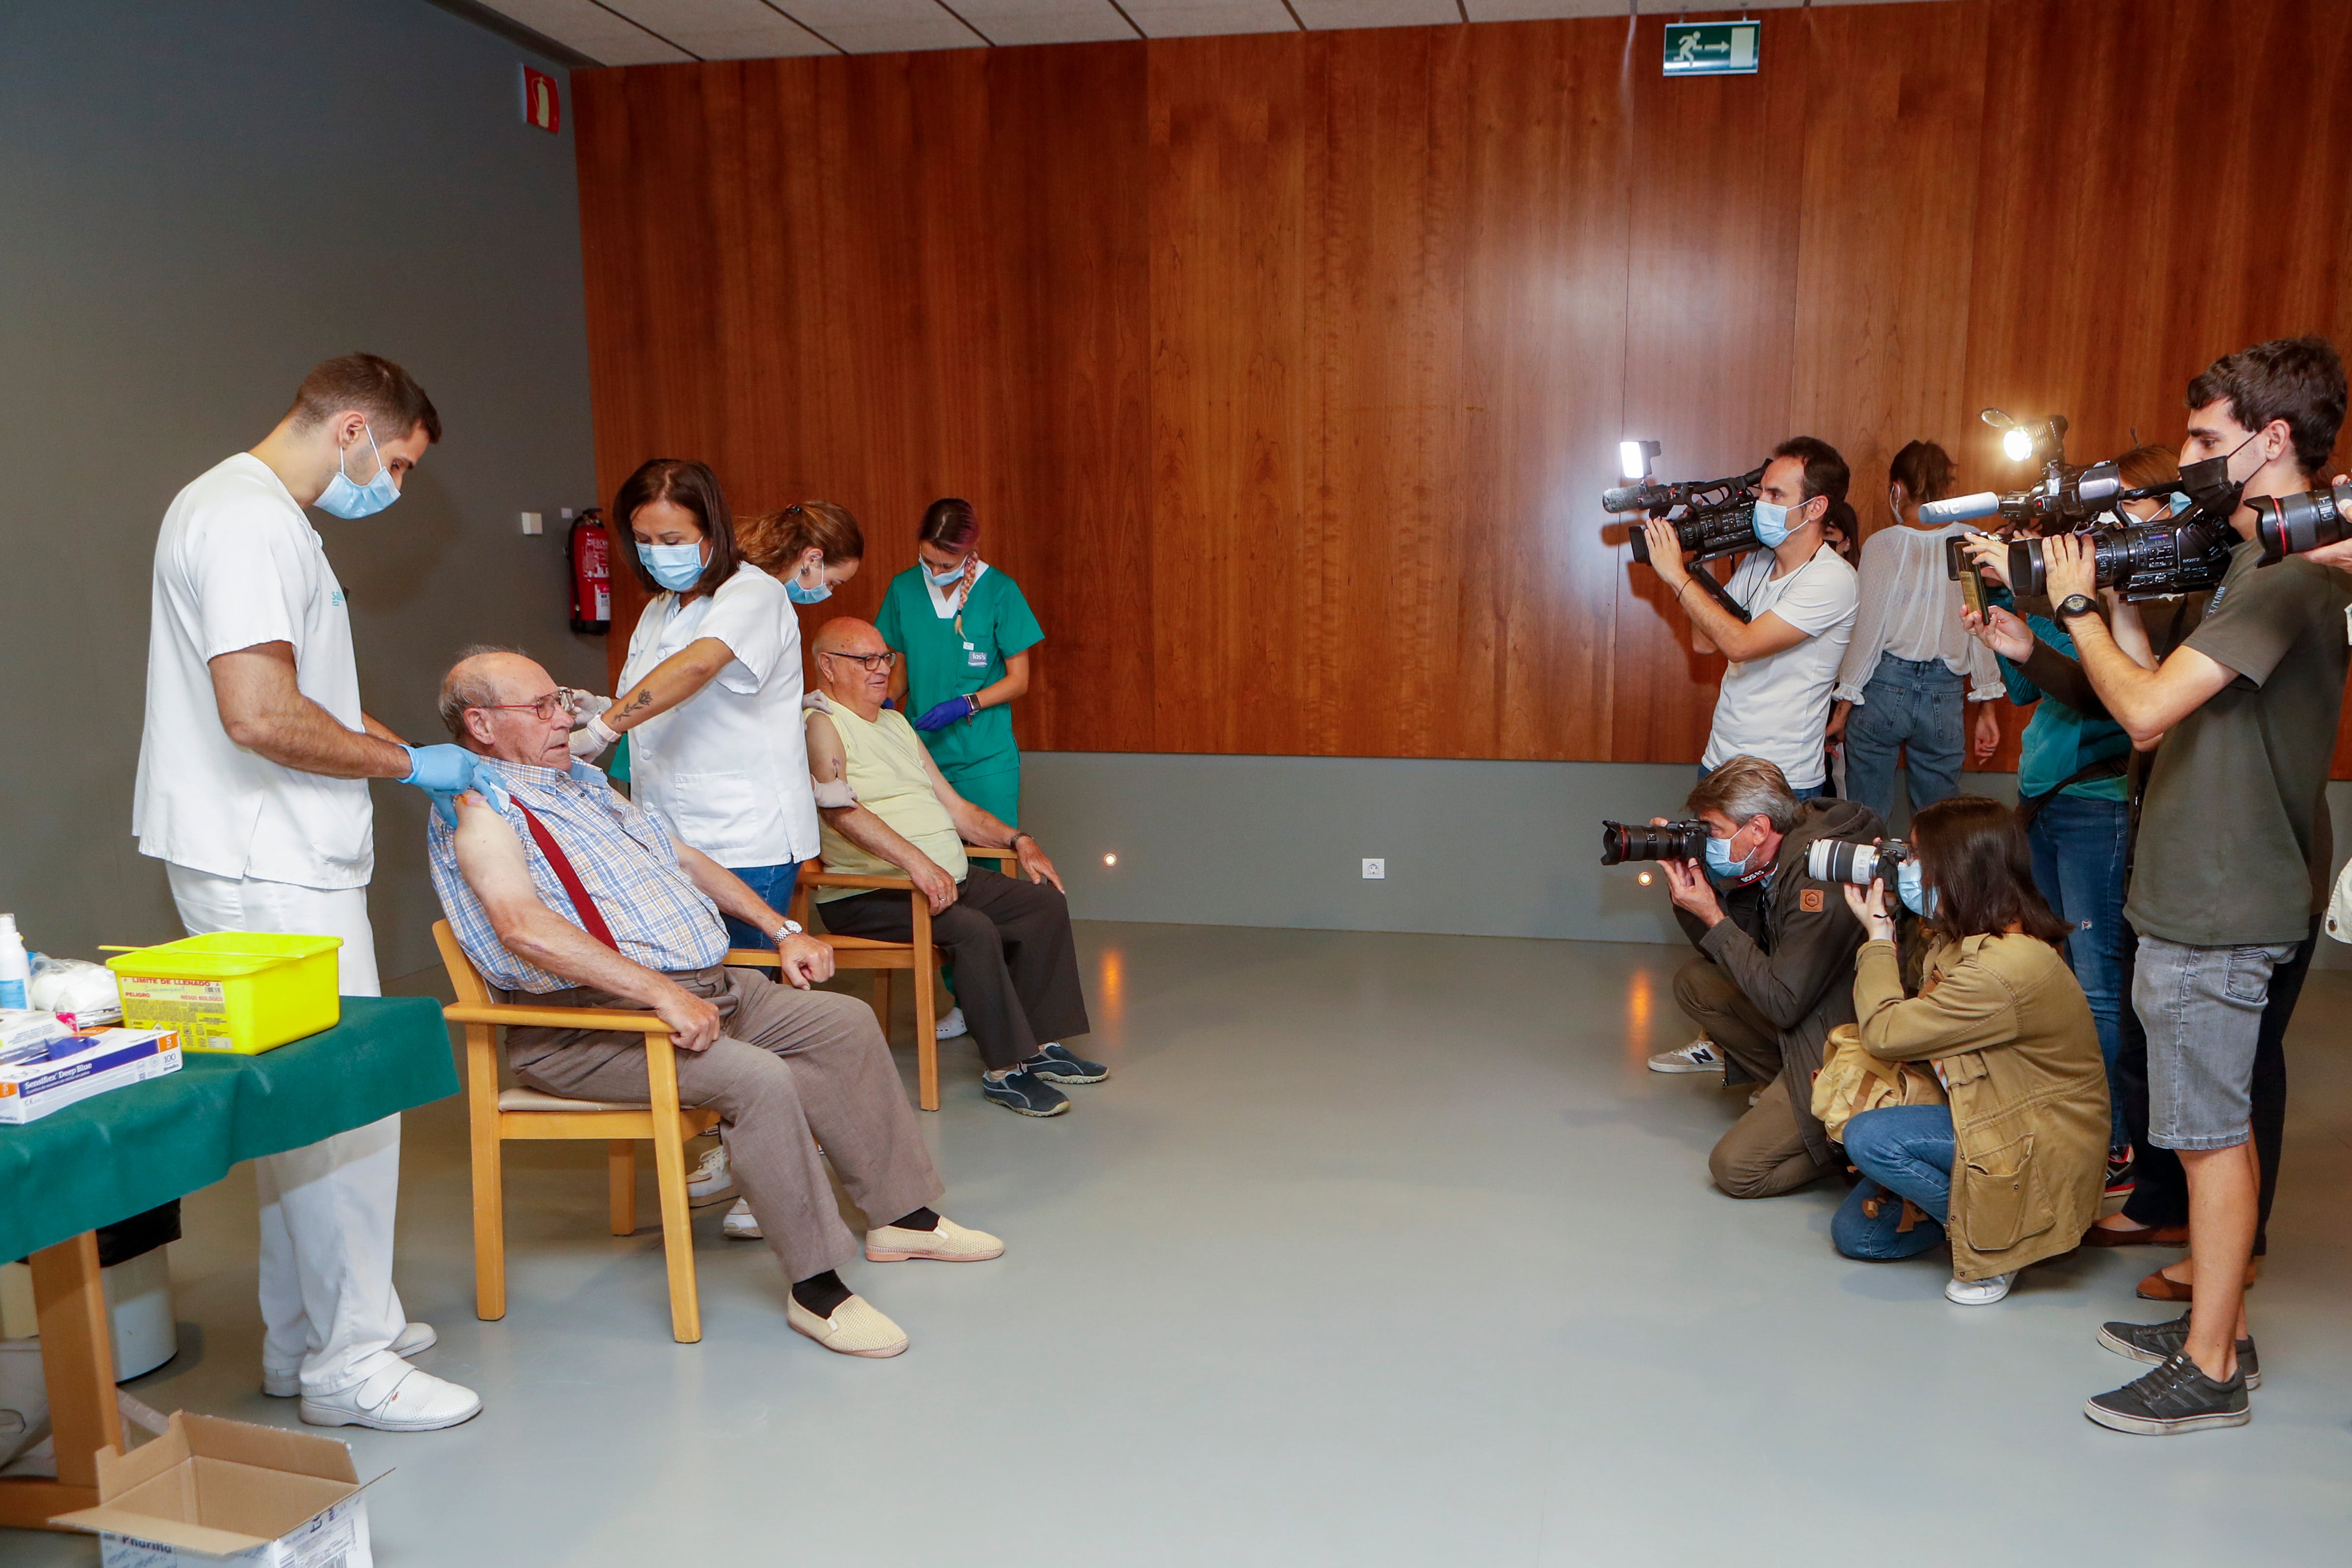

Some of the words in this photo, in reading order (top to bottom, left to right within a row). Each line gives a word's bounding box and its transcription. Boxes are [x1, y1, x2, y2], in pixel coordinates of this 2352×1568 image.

[166, 1036, 172, 1044] S
[164, 1053, 176, 1064] 100
[58, 1068, 76, 1079] Deep
[76, 1063, 93, 1072] Blue
